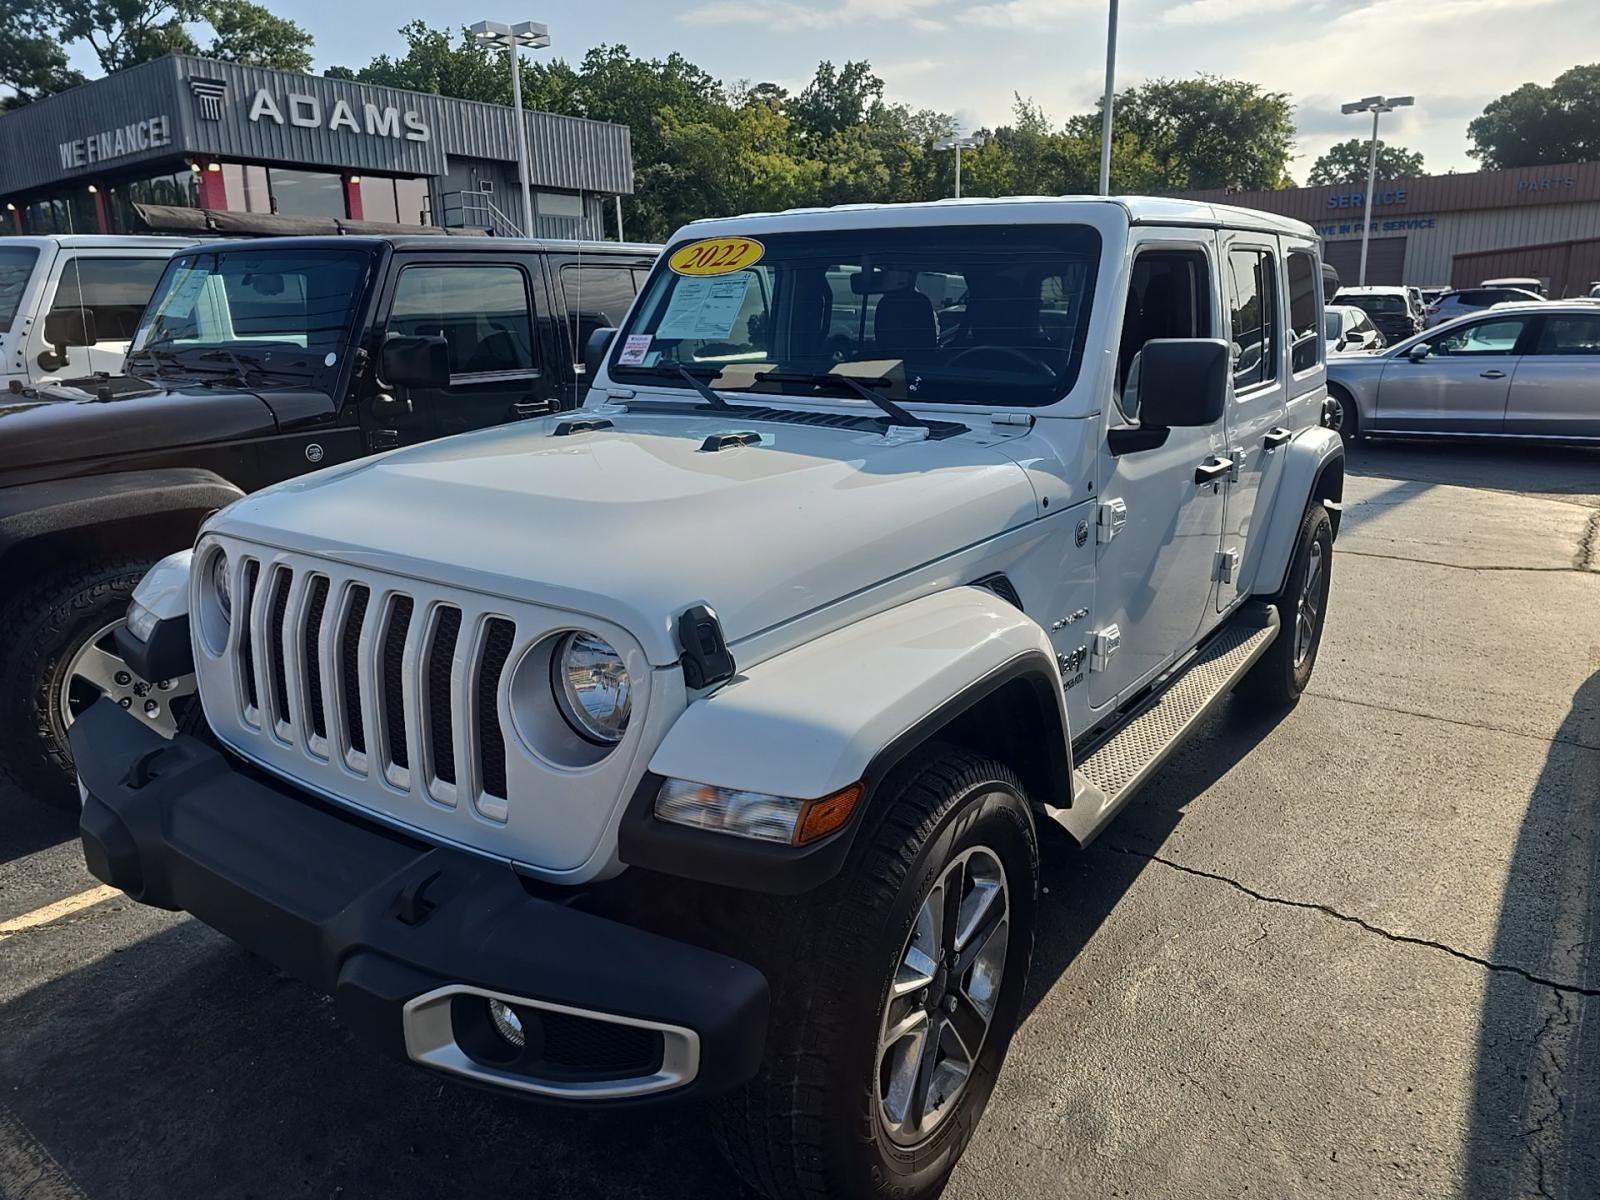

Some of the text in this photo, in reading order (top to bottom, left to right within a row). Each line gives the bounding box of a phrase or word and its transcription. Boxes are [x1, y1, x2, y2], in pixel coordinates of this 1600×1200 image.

[249, 88, 431, 142] ADAMS
[60, 115, 171, 169] WE FINANCE!
[1517, 176, 1577, 192] PARTS
[1339, 223, 1351, 234] IN
[1382, 219, 1435, 231] SERVICE
[680, 243, 750, 268] 2022
